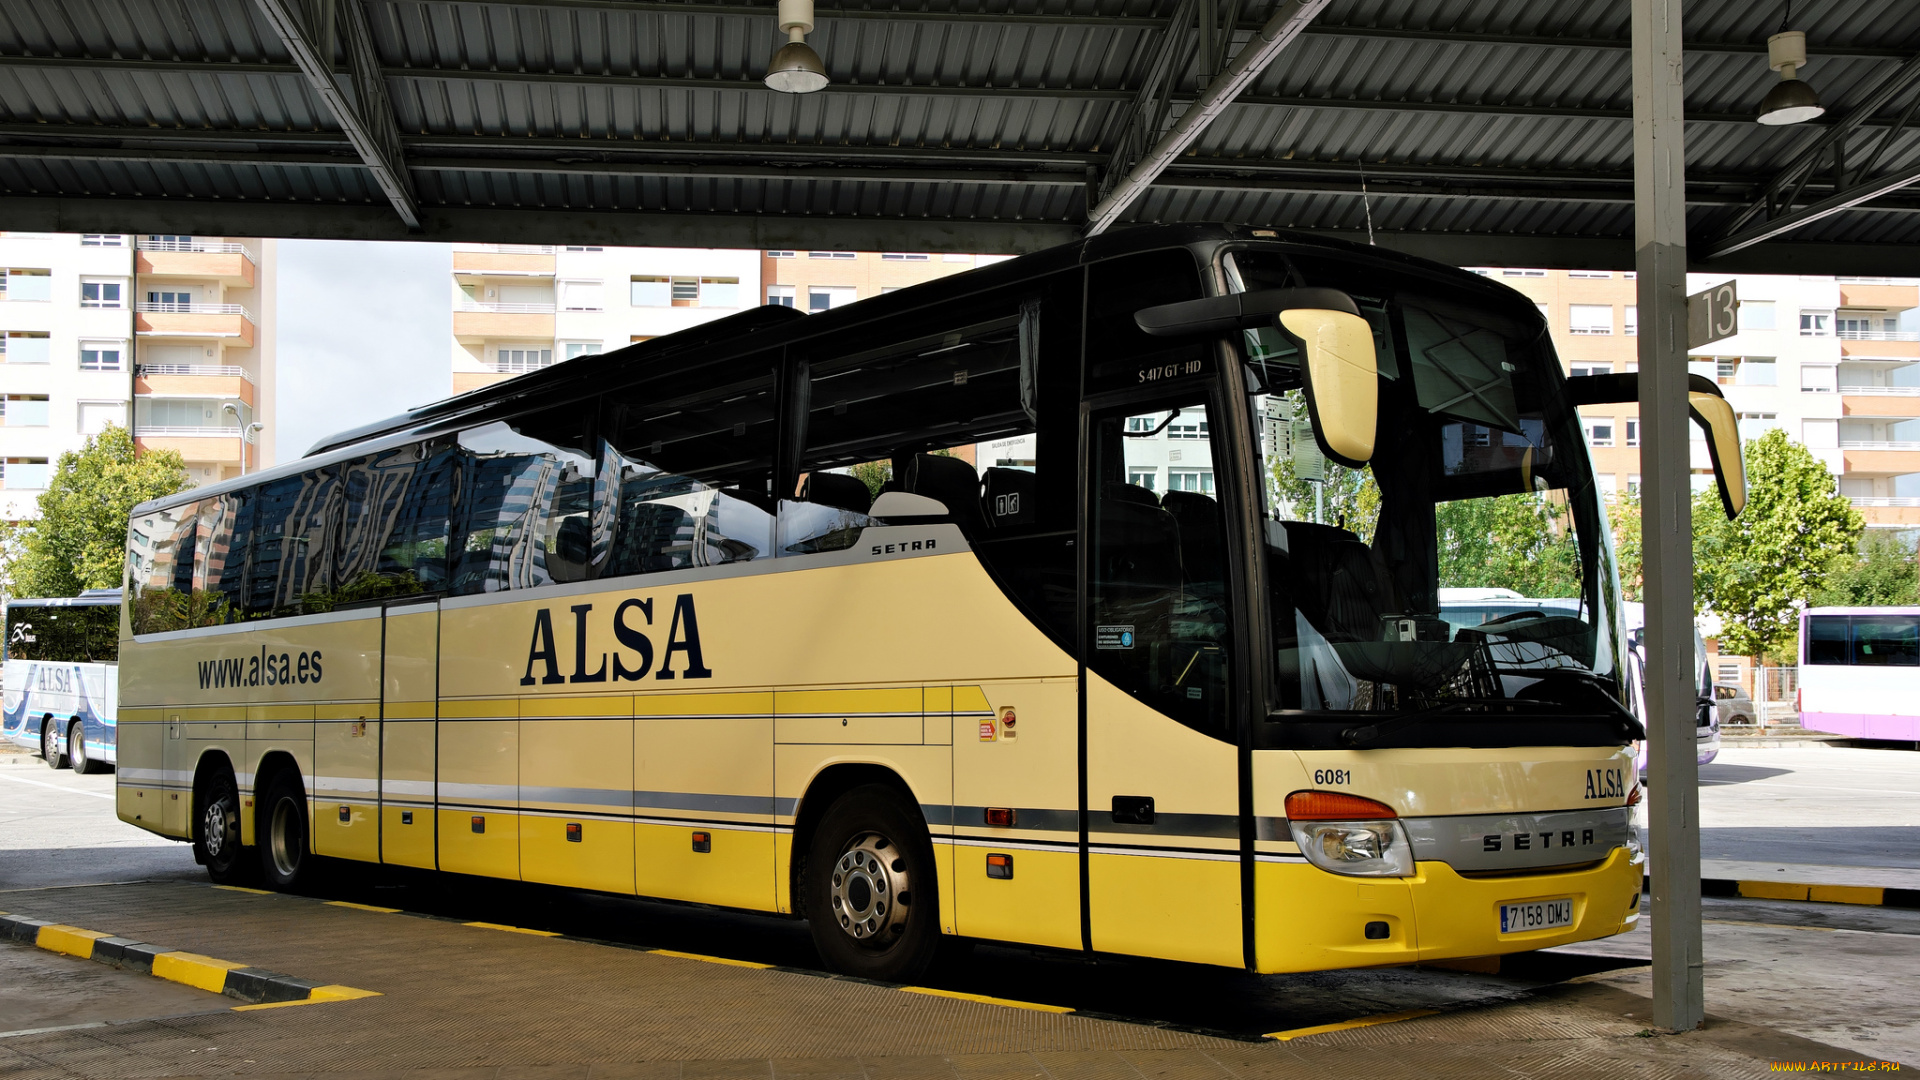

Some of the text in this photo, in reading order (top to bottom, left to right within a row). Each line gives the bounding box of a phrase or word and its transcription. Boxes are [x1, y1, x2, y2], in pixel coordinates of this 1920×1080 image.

[1703, 285, 1735, 339] 13
[1138, 370, 1146, 383] S
[1146, 366, 1163, 381] 417
[872, 539, 936, 555] SETRA
[520, 593, 712, 686] ALSA
[198, 644, 322, 689] www.alsa.es
[38, 667, 72, 693] ALSA
[1314, 769, 1351, 785] 6081
[1584, 769, 1625, 799] ALSA
[1483, 829, 1594, 852] SETRA
[1510, 902, 1570, 928] 7158 DMJ
